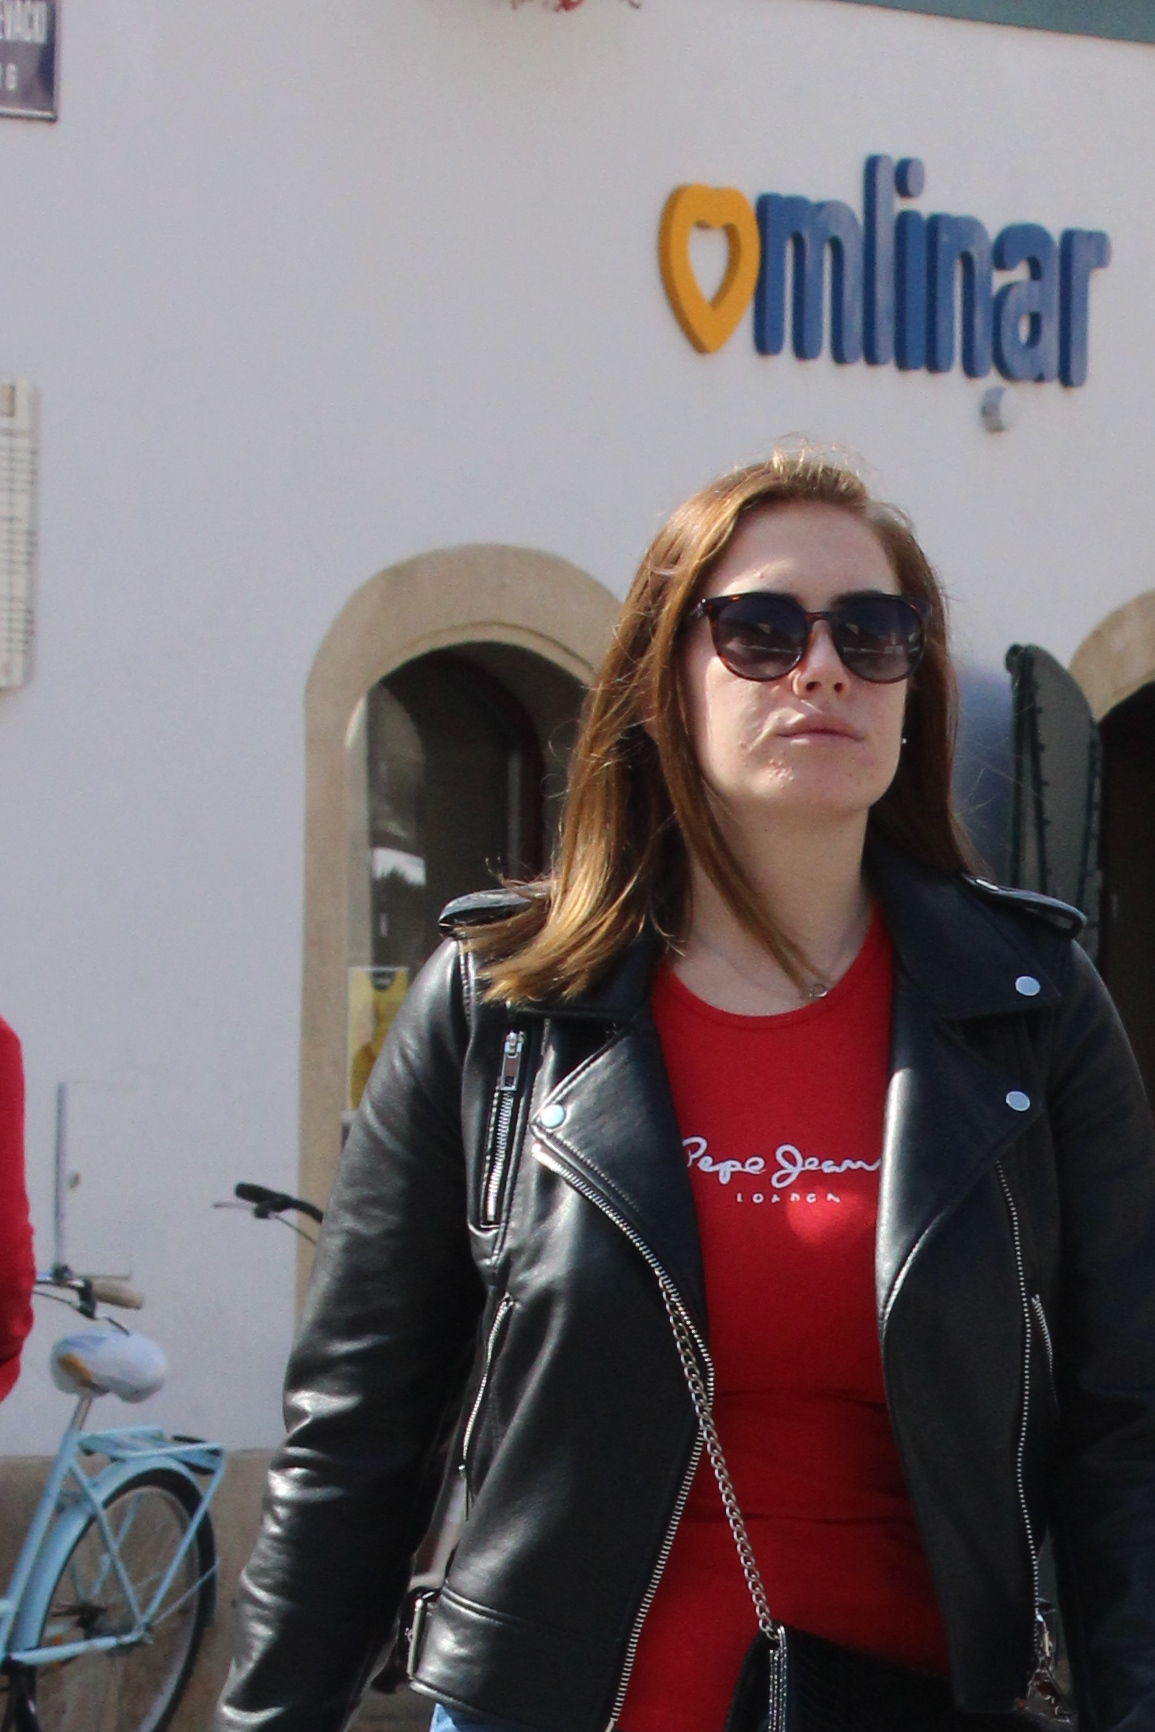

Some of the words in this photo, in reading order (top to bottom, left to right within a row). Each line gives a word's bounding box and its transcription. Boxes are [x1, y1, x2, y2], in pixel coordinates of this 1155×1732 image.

[753, 154, 1113, 388] mlinar
[682, 1136, 766, 1185] Pepe
[771, 1144, 881, 1189] Jean
